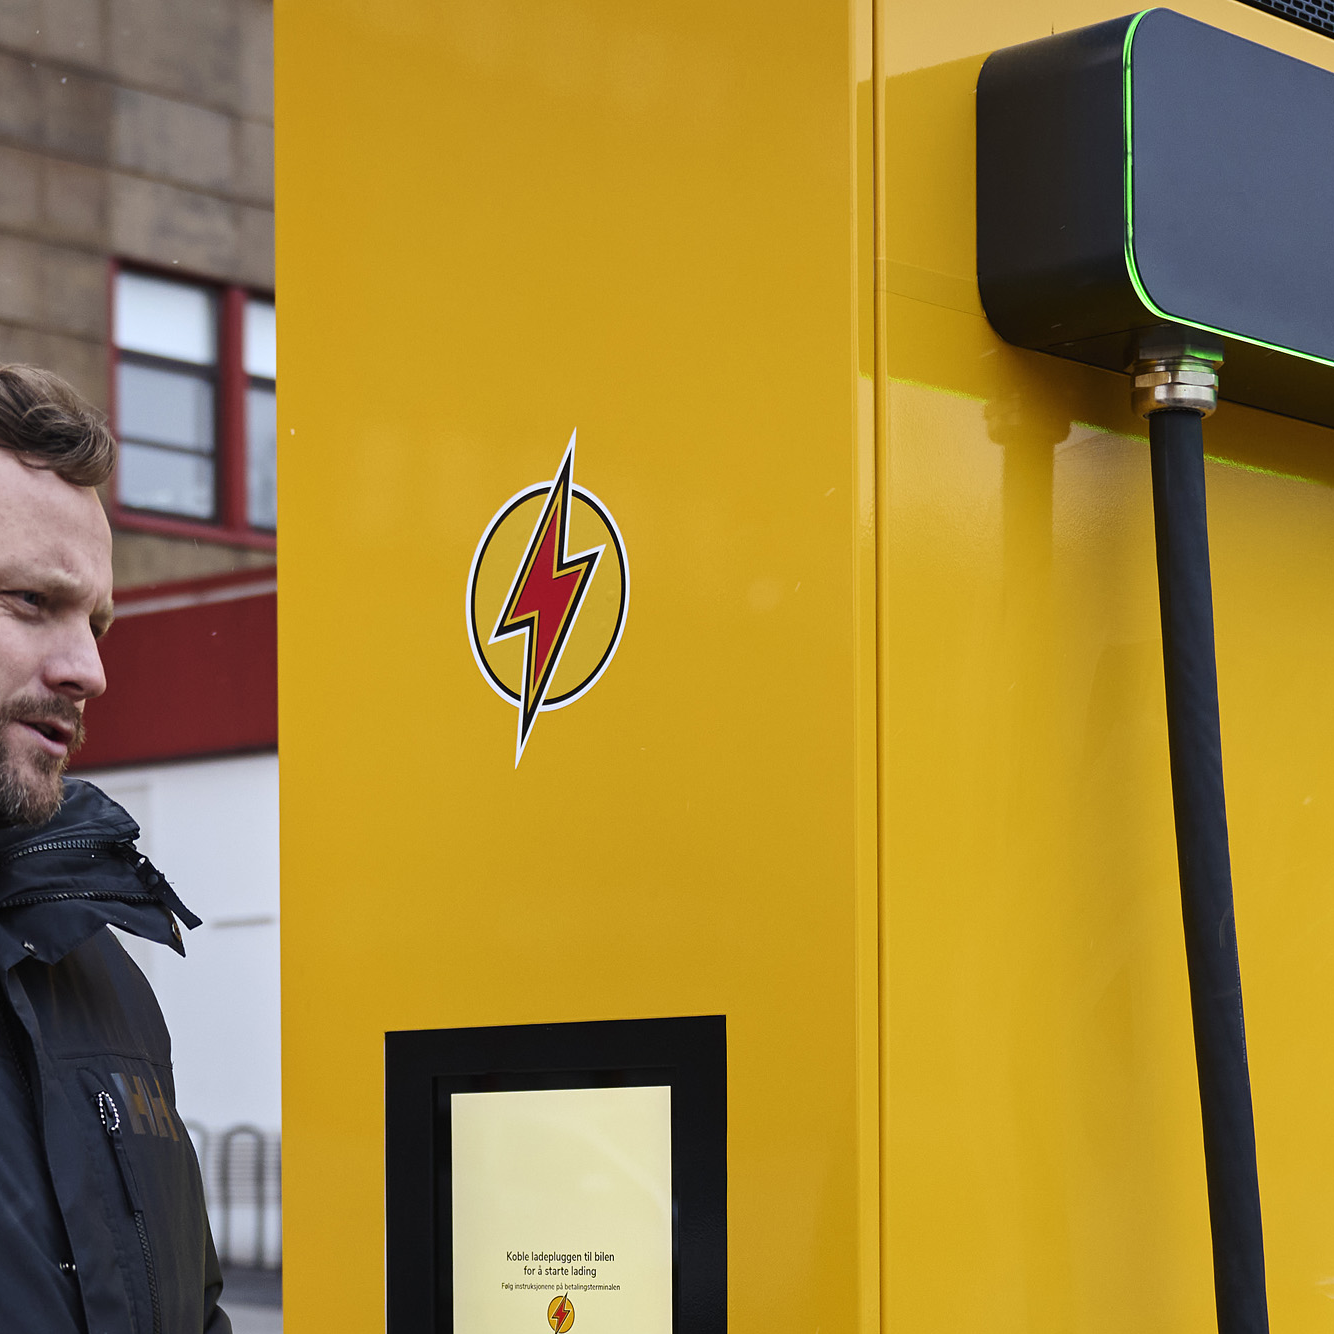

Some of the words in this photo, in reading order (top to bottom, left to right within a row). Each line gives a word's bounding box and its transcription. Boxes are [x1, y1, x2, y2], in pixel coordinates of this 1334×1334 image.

[506, 1251, 529, 1262] Koble
[531, 1251, 582, 1264] ladepluggen
[584, 1251, 592, 1262] til
[594, 1251, 615, 1262] bilen
[523, 1265, 536, 1276] for
[537, 1265, 543, 1276] å
[544, 1266, 569, 1276] starte
[571, 1266, 597, 1279] lading
[514, 1282, 555, 1292] instruksjonene
[555, 1282, 564, 1292] på
[564, 1283, 621, 1292] betalingsterminalen
